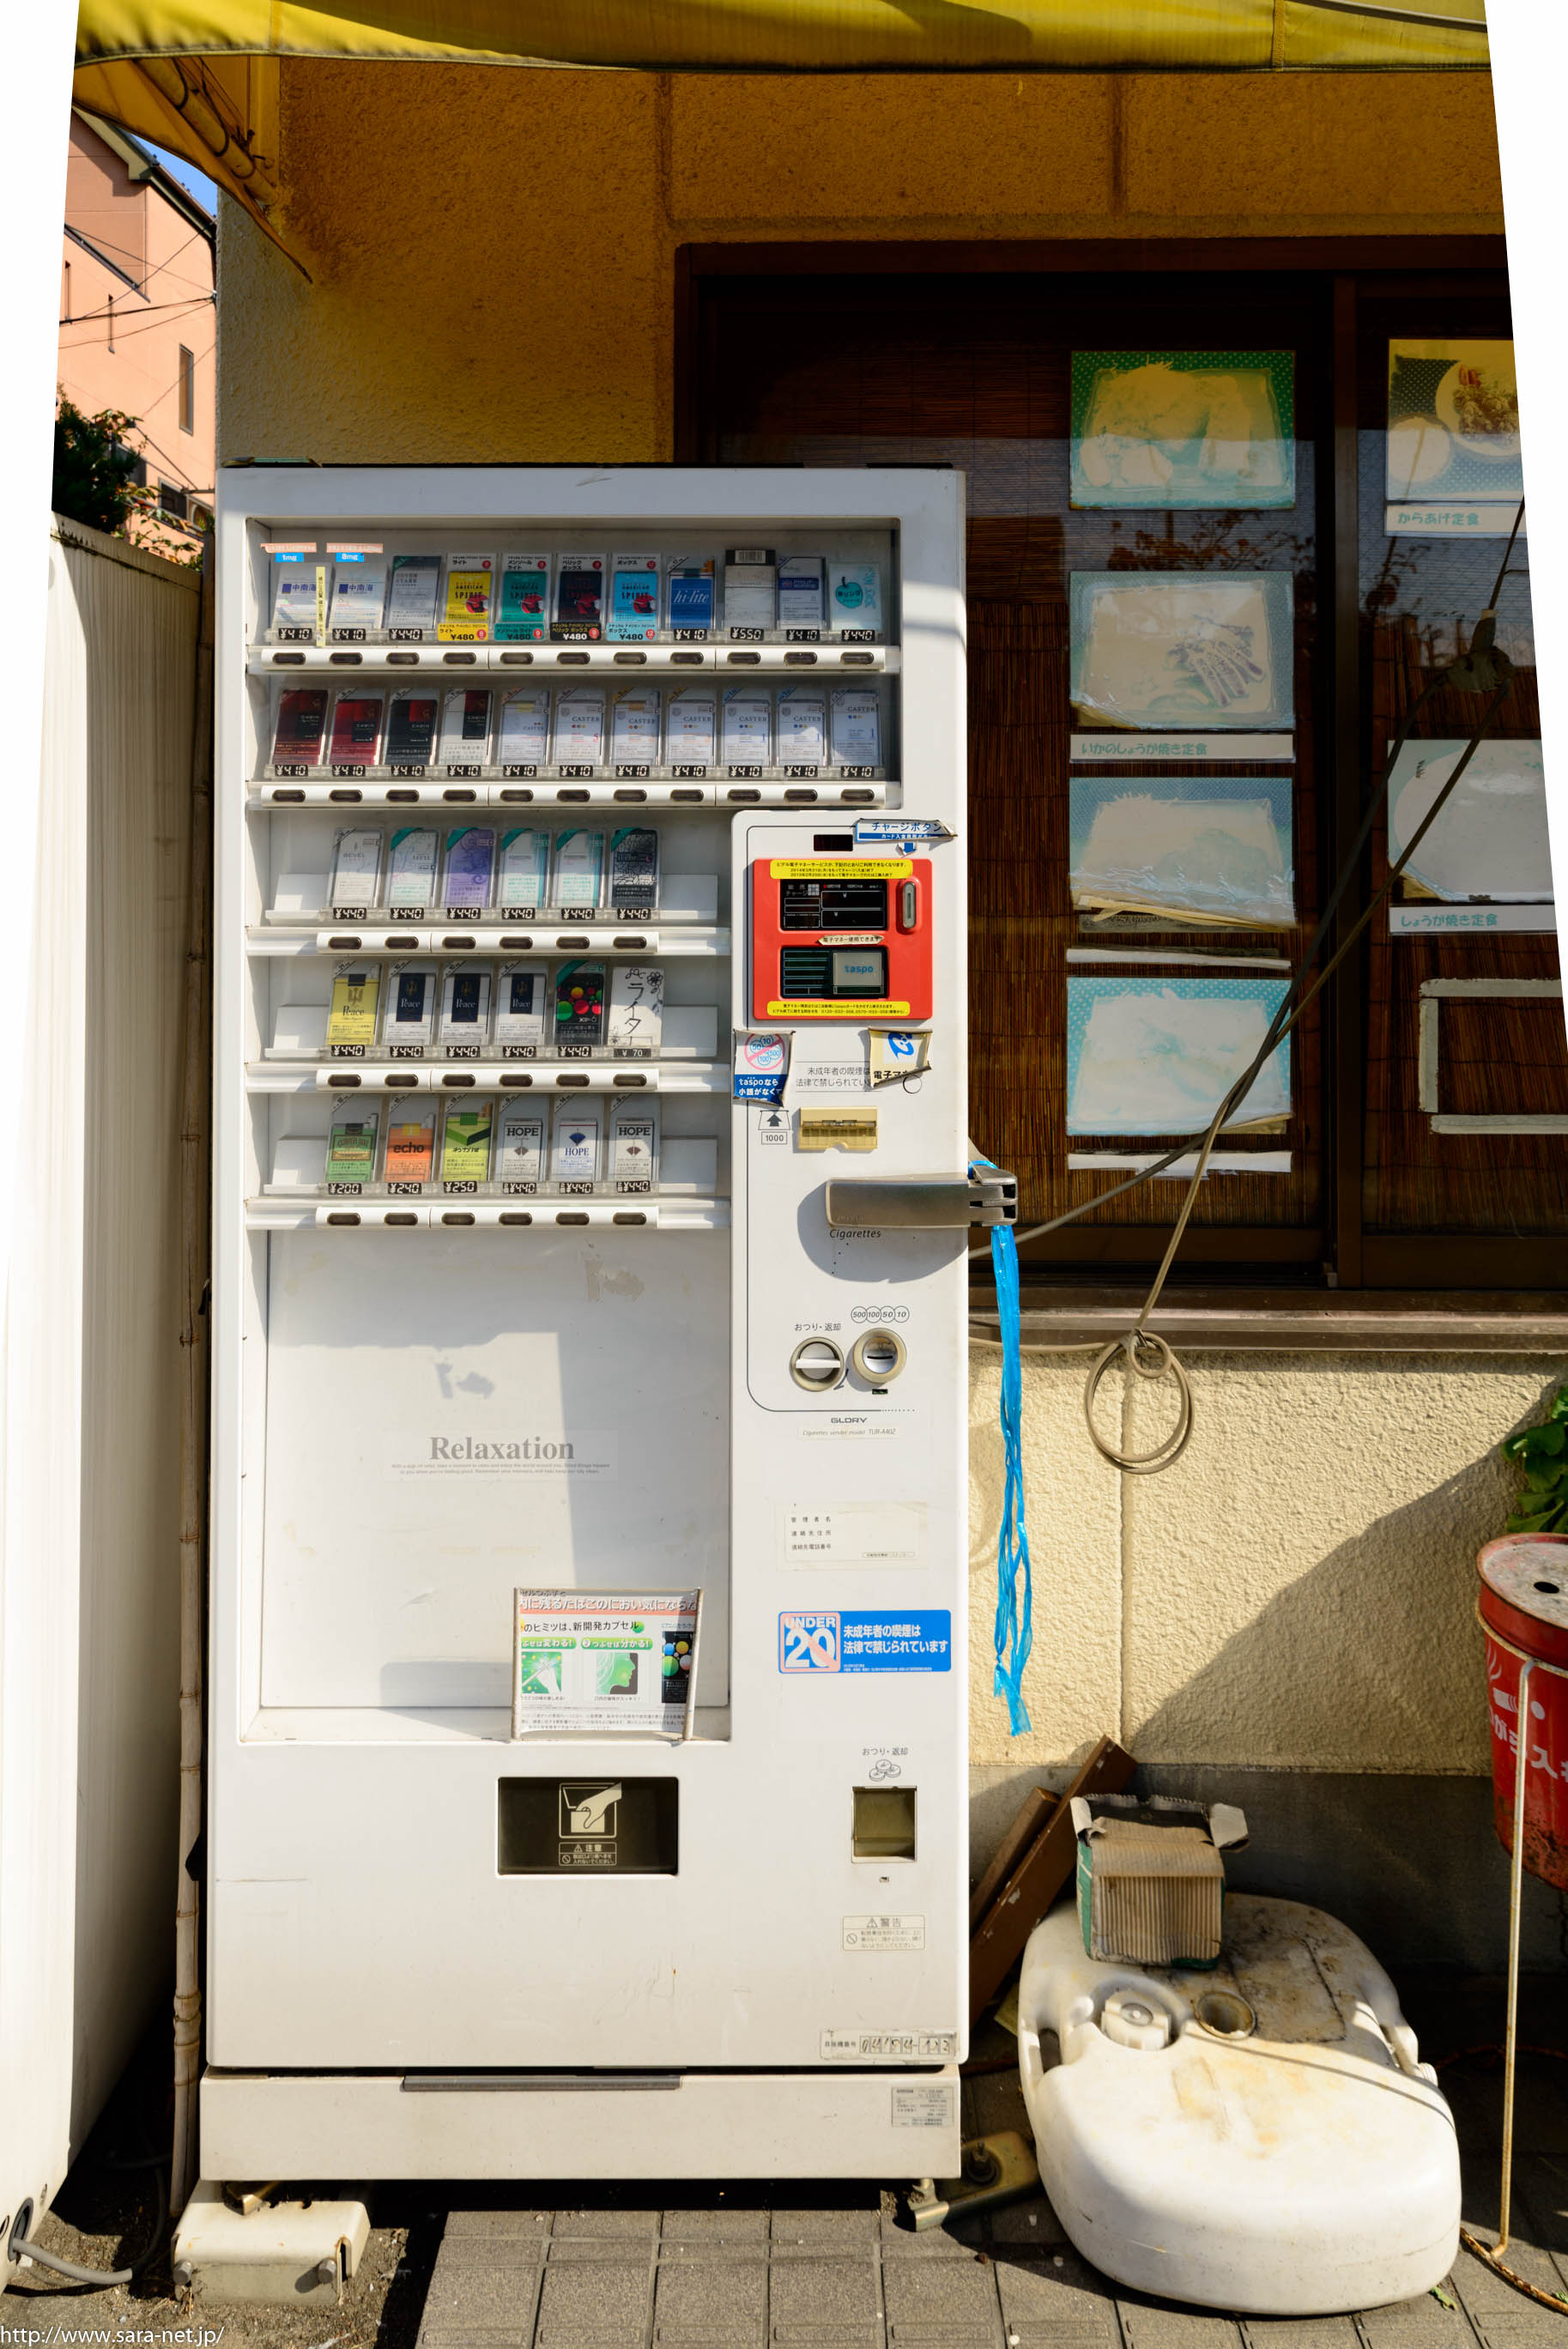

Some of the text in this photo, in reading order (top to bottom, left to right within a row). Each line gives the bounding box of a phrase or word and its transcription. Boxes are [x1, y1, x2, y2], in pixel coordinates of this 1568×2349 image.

[1398, 512, 1480, 526] からあげ定食
[292, 584, 317, 592] 中南海
[348, 584, 374, 592] 中南海
[674, 590, 709, 603] hi-lite
[281, 628, 310, 639] ¥410
[335, 629, 364, 640] ¥410
[390, 629, 421, 640] ¥440
[675, 629, 705, 640] ¥410
[732, 627, 761, 639] ¥550
[789, 630, 817, 640] ¥410
[844, 630, 873, 640] ¥440
[1081, 742, 1208, 755] いかのしょうが焼き定食
[277, 766, 306, 776] ¥410
[335, 766, 364, 776] ¥410
[393, 766, 423, 776] ¥410
[450, 766, 479, 776] ¥410
[505, 766, 535, 776] ¥410
[561, 766, 591, 776] ¥410
[618, 766, 647, 776] ¥410
[675, 766, 704, 776] ¥410
[731, 766, 760, 777] ¥410
[787, 766, 816, 777] ¥410
[844, 766, 873, 777] ¥410
[872, 821, 942, 832] チャージボタン
[336, 908, 365, 919] ¥440
[393, 908, 422, 919] ¥440
[450, 908, 479, 919] ¥440
[504, 908, 533, 919] ¥440
[563, 908, 593, 919] ¥440
[619, 908, 649, 919] ¥440
[1401, 913, 1498, 928] しょうが焼き定食
[845, 965, 874, 975] taspo
[401, 998, 421, 1008] Peace
[456, 998, 475, 1008] Peace
[512, 998, 531, 1008] Peace
[342, 1005, 365, 1016] Peace
[334, 1045, 363, 1056] ¥440
[392, 1046, 421, 1057] ¥440
[449, 1046, 478, 1057] ¥440
[505, 1046, 535, 1057] ¥440
[560, 1046, 590, 1057] ¥440
[506, 1127, 539, 1136] HOPE
[619, 1127, 651, 1135] HOPE
[393, 1141, 425, 1153] echo
[565, 1147, 590, 1156] HOPE
[330, 1184, 360, 1194] ¥200
[390, 1184, 419, 1194] ¥240
[445, 1182, 475, 1192] ¥250
[510, 1183, 535, 1193] ¥440
[566, 1183, 592, 1193] ¥440
[623, 1182, 649, 1192] ¥440
[829, 1229, 881, 1238] Cigarettes
[795, 1323, 841, 1331] おつり・返却
[429, 1436, 574, 1460] Relaxation
[784, 1616, 836, 1628] UNDER
[844, 1624, 921, 1638] 未成年者の喫煙は
[785, 1627, 837, 1668] 20
[844, 1640, 948, 1655] 法律で禁じられています
[862, 1747, 909, 1756] おつり・返却
